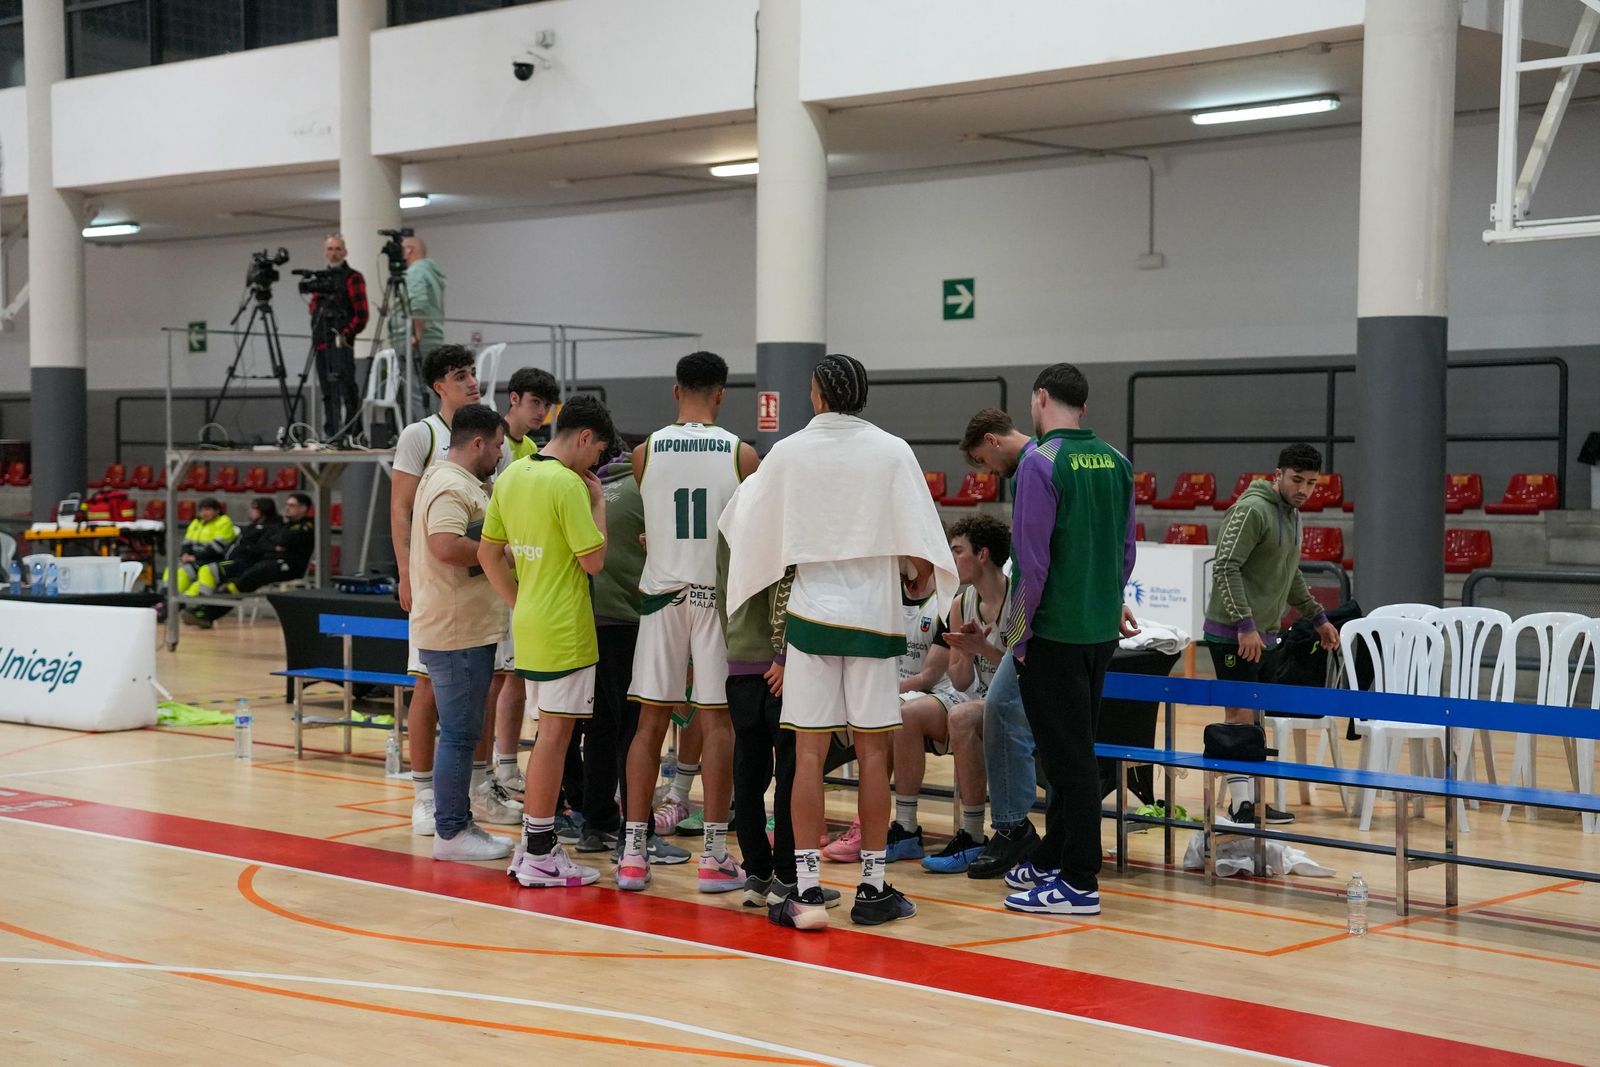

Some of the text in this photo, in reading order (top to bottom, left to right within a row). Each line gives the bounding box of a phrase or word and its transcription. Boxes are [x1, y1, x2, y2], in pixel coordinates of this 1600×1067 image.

[654, 439, 731, 453] IKPONMWOSA
[674, 488, 707, 539] 11
[690, 590, 708, 600] DEL
